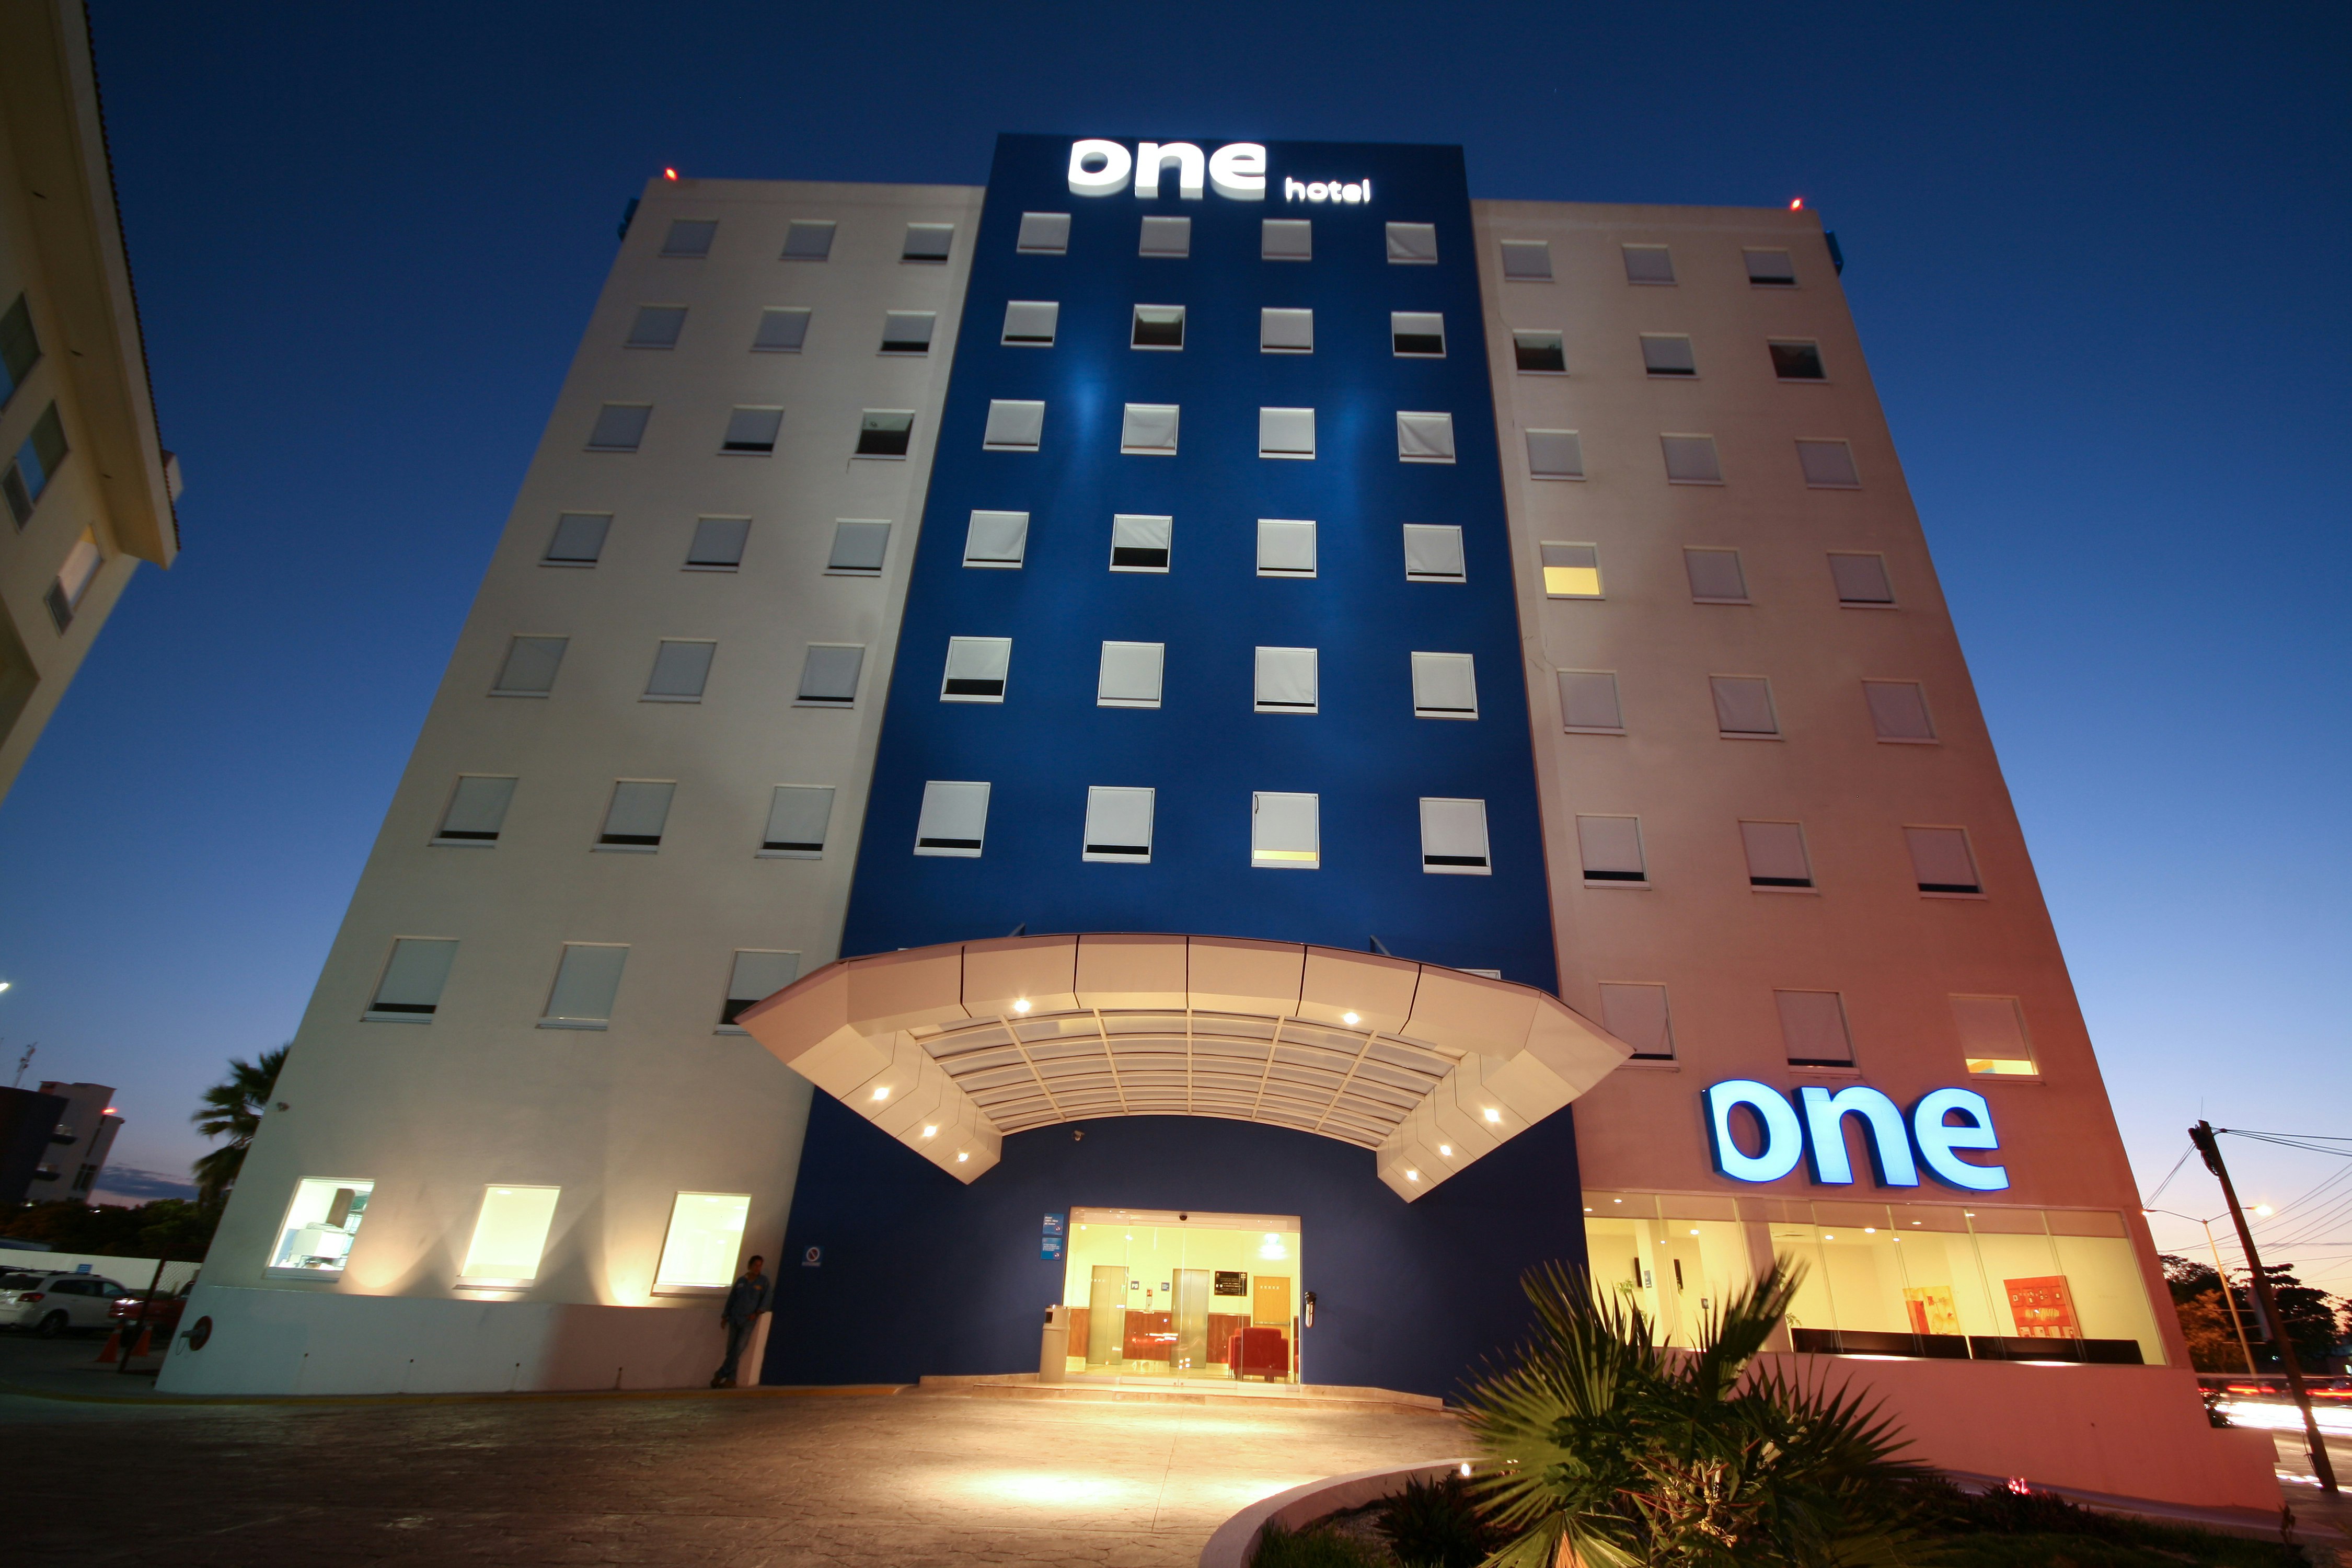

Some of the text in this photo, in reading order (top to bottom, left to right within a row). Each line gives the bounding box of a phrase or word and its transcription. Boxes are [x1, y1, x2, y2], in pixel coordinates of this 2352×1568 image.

[1068, 139, 1371, 203] one hotel
[1704, 1079, 2010, 1191] one
